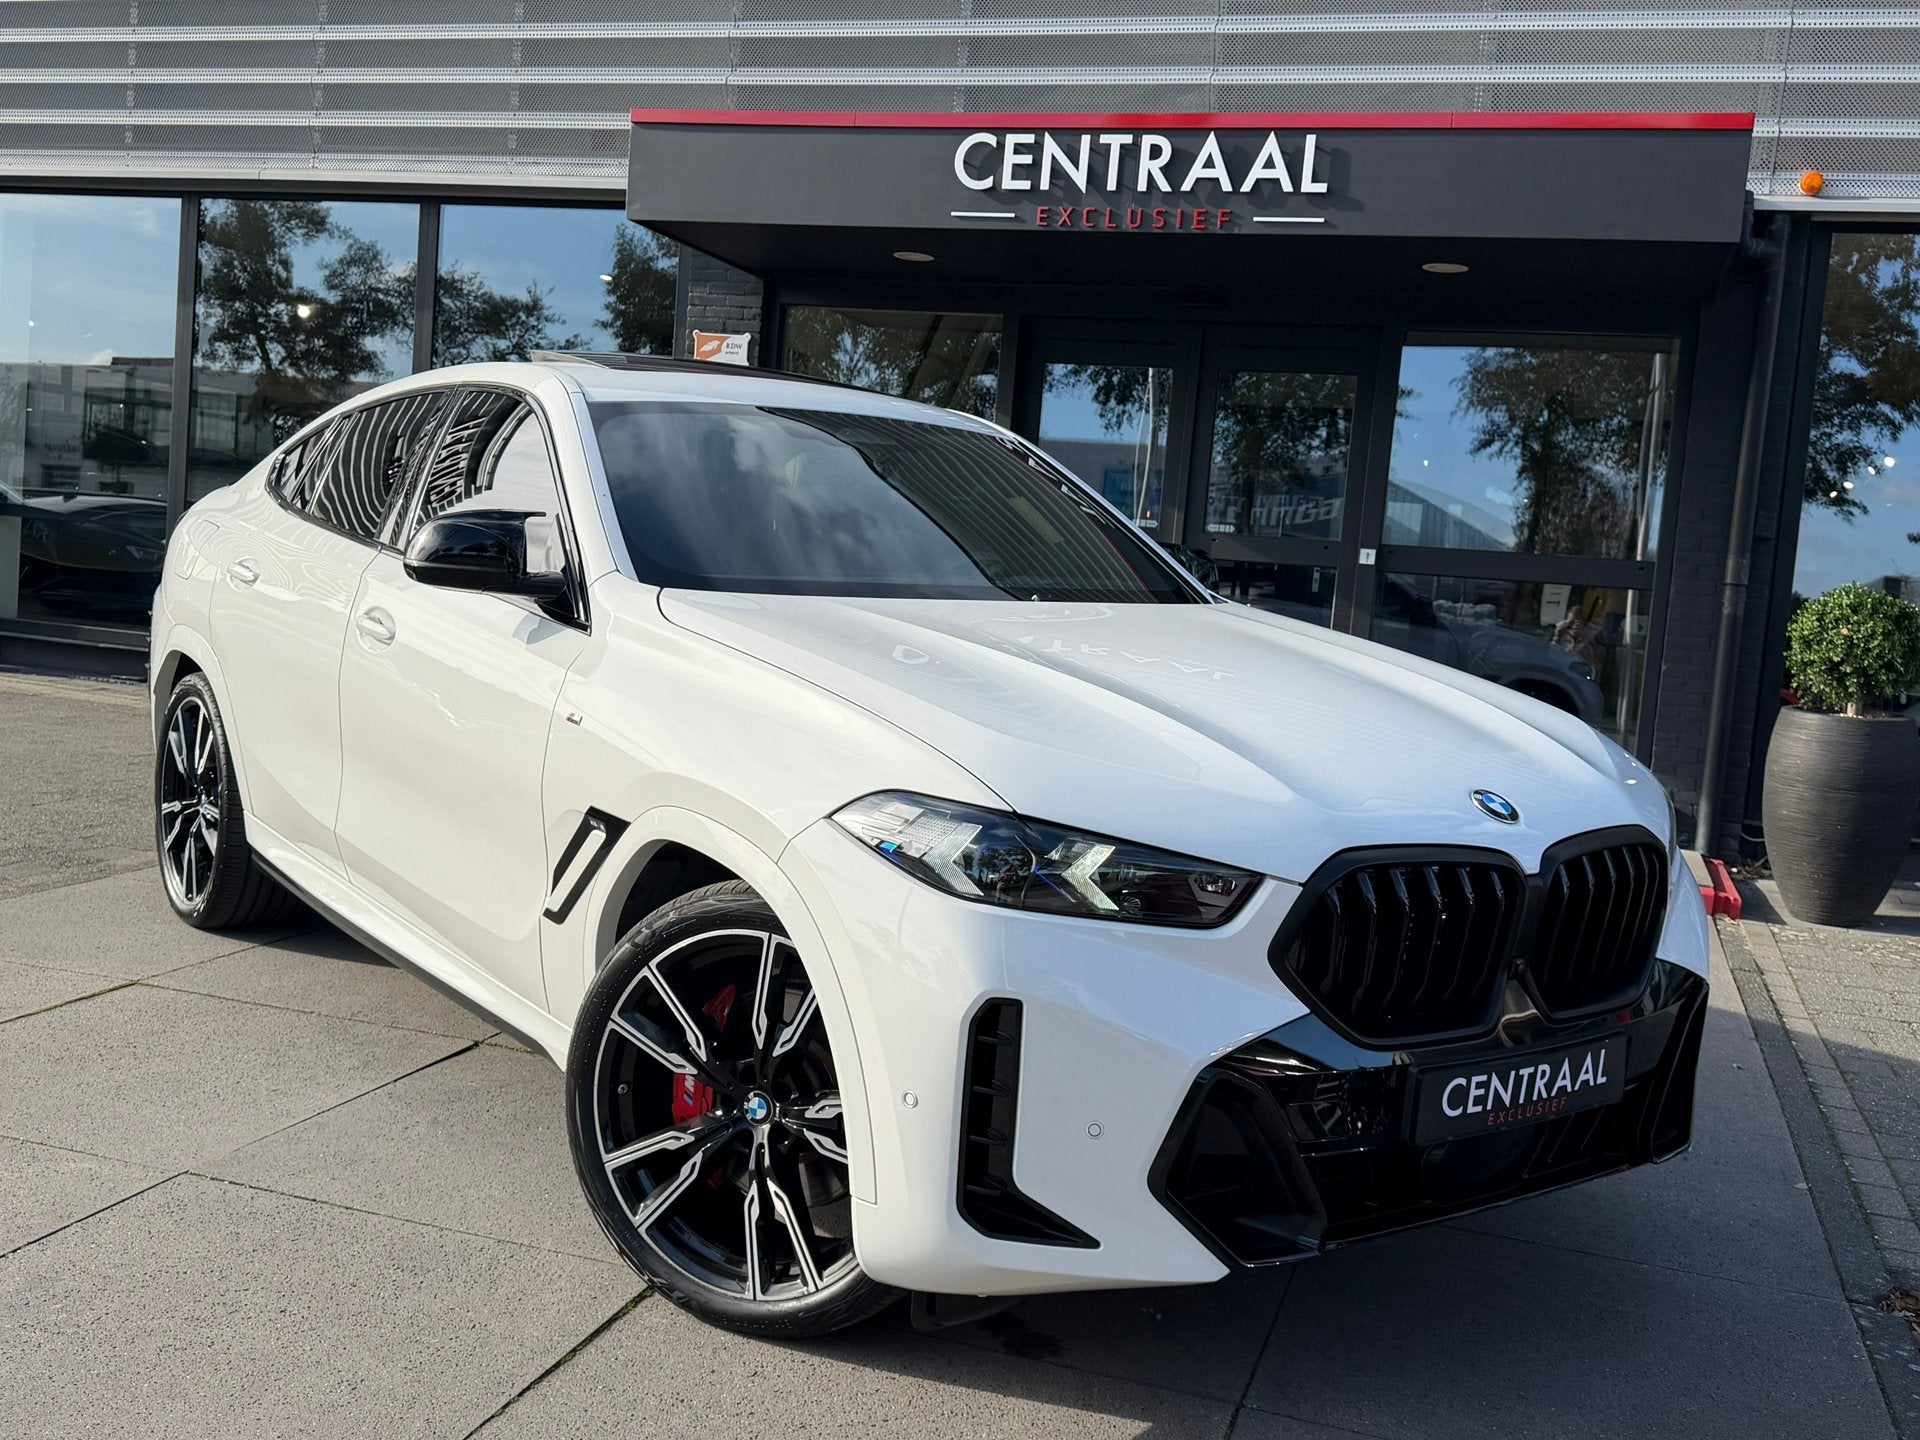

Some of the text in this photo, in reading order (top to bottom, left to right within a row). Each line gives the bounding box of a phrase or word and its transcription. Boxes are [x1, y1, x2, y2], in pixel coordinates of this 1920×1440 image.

[954, 130, 1329, 193] CENTRAAL
[1036, 205, 1233, 230] EXCLUSIEF
[1441, 1048, 1608, 1117] CENTRAAL
[1487, 1096, 1568, 1126] EXCLUSIEF
